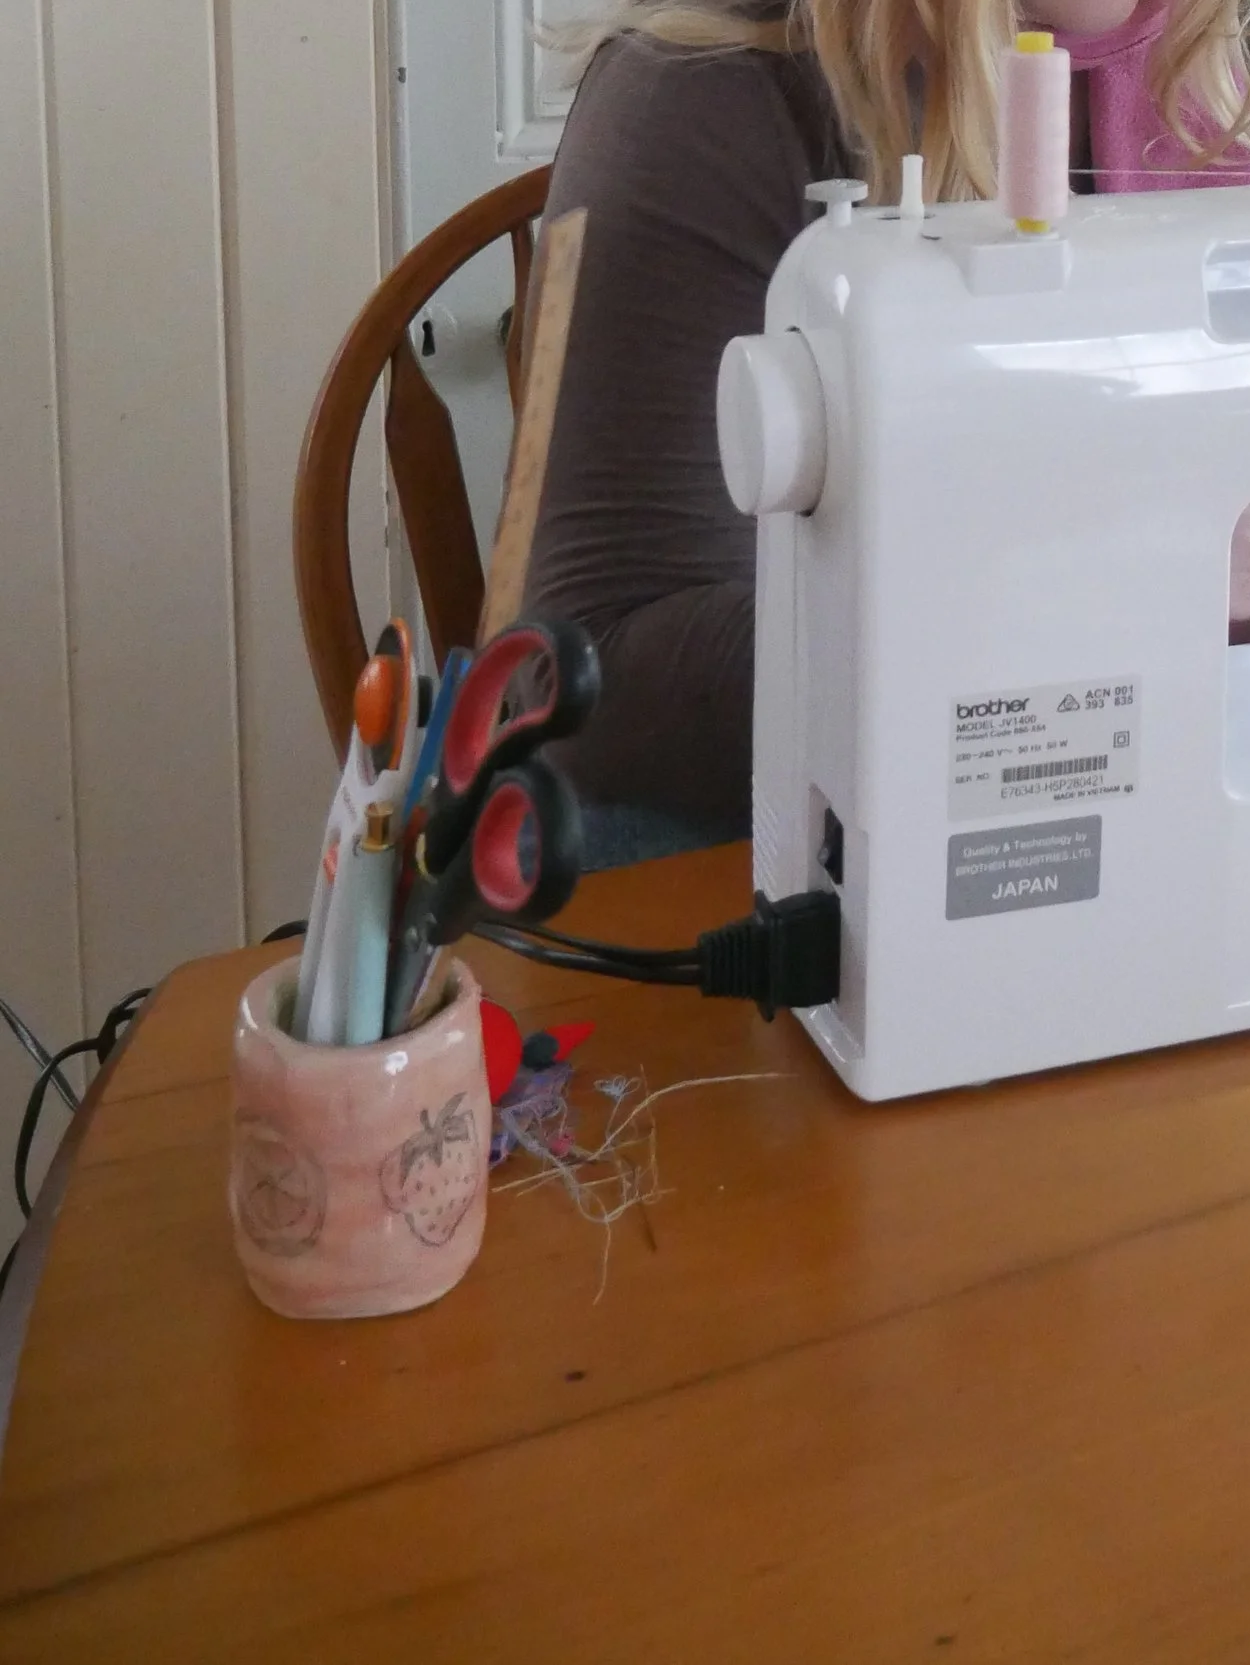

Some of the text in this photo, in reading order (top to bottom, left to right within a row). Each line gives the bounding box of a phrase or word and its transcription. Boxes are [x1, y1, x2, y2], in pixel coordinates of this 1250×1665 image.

[1085, 685, 1134, 701] ACN 001
[956, 697, 1030, 720] brother
[1085, 698, 1105, 710] 393
[956, 714, 1037, 733] MODEL JV1400
[963, 832, 1088, 859] Quality & Technology by
[991, 874, 1059, 900] JAPAN
